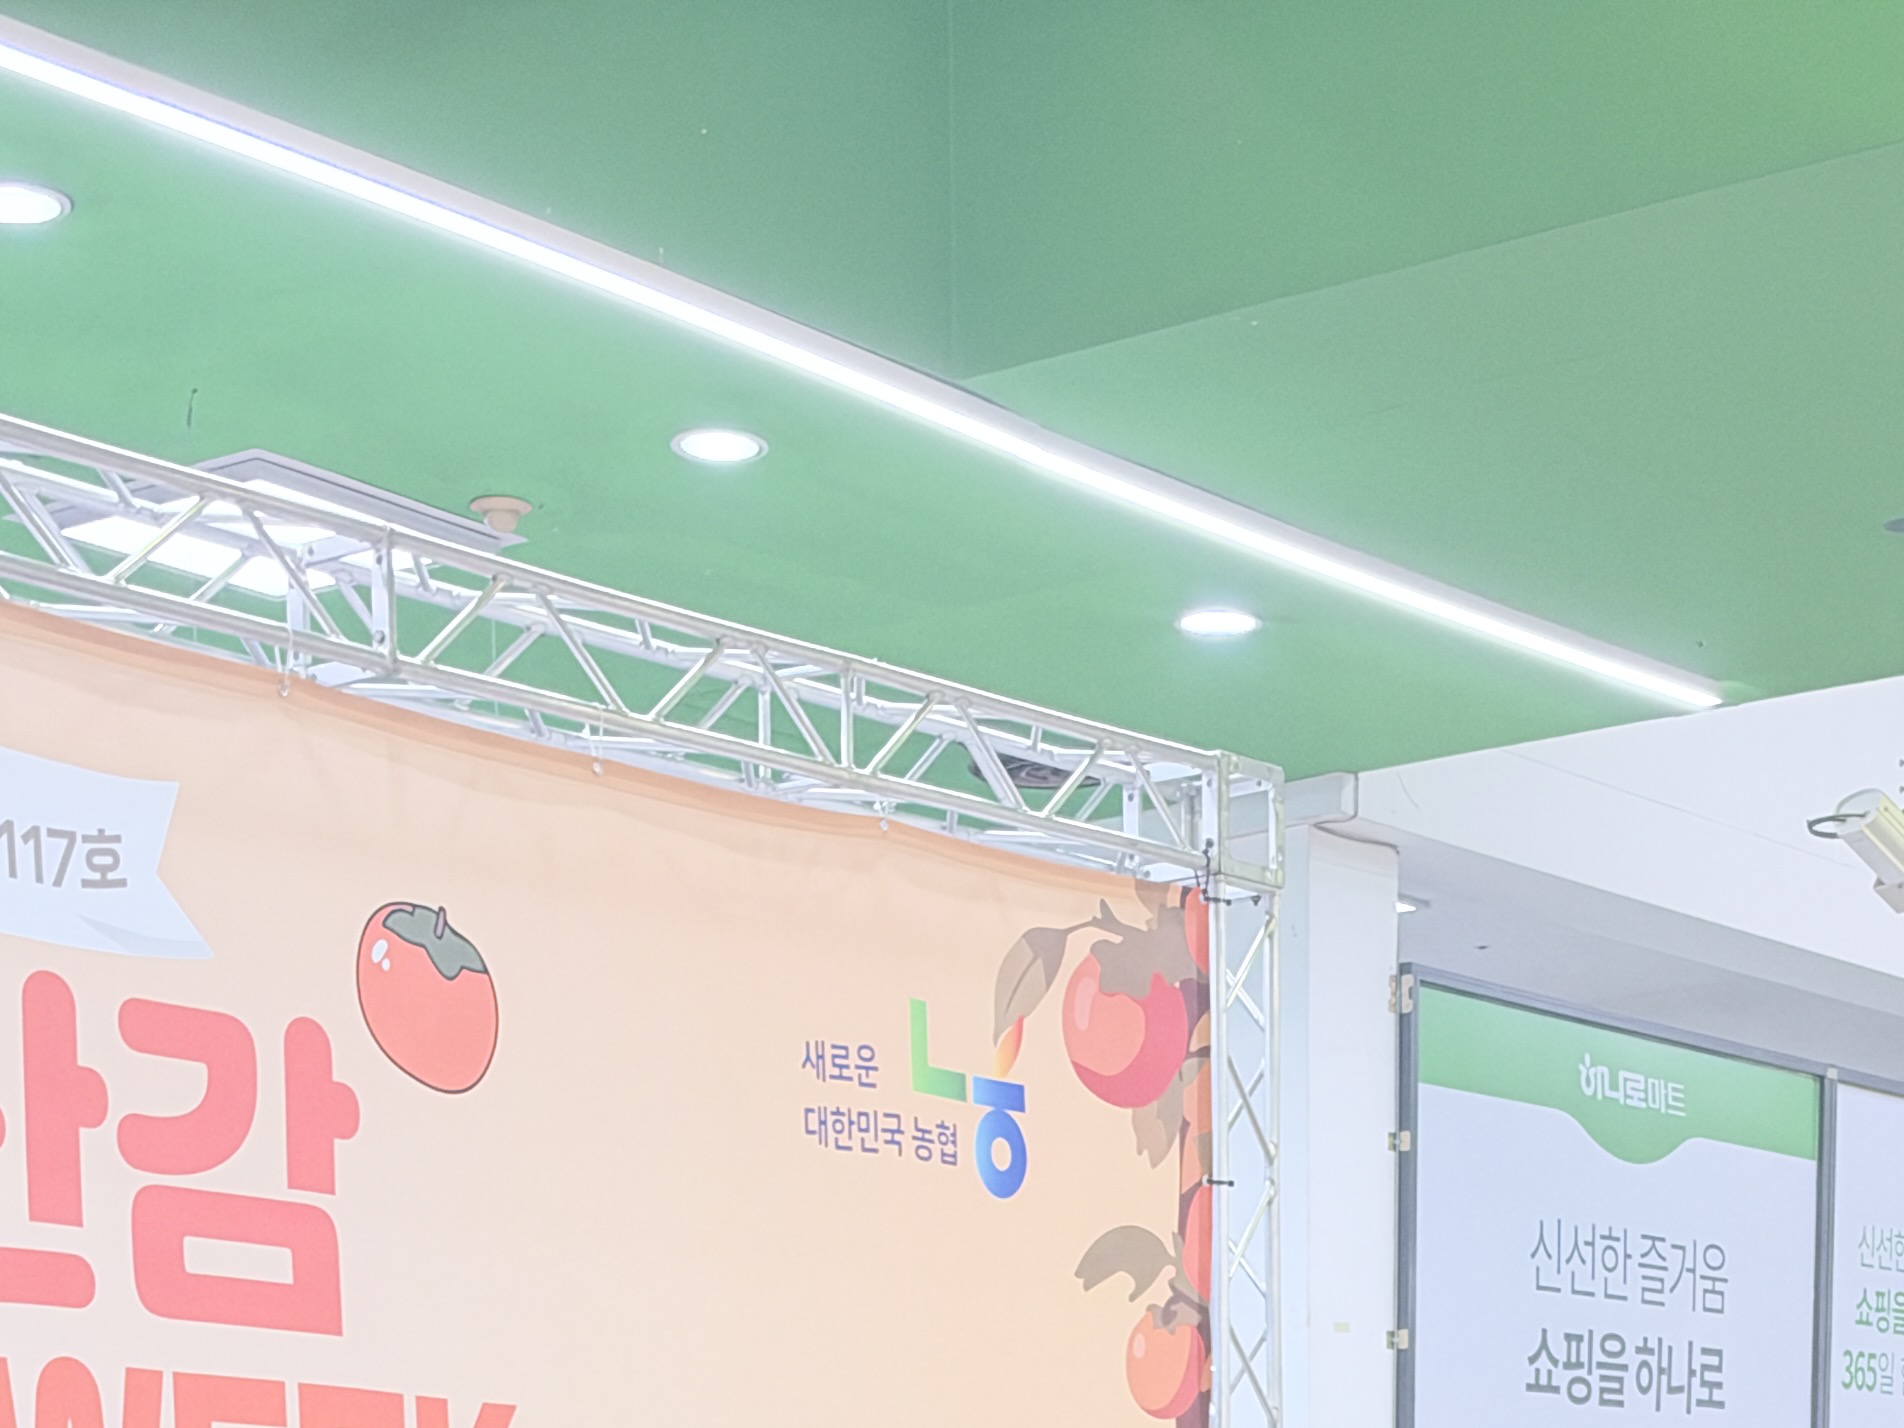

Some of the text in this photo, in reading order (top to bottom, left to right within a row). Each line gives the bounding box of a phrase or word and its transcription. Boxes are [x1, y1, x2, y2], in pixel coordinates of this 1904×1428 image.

[801, 1039, 880, 1089] 새로운
[1577, 1053, 1688, 1118] 하나로마트
[802, 1105, 960, 1167] 대한민국 농협
[1529, 1217, 1730, 1316] 신선한 즐거움
[1526, 1327, 1727, 1416] 쇼핑을 하나로
[1841, 1347, 1895, 1397] 365일
